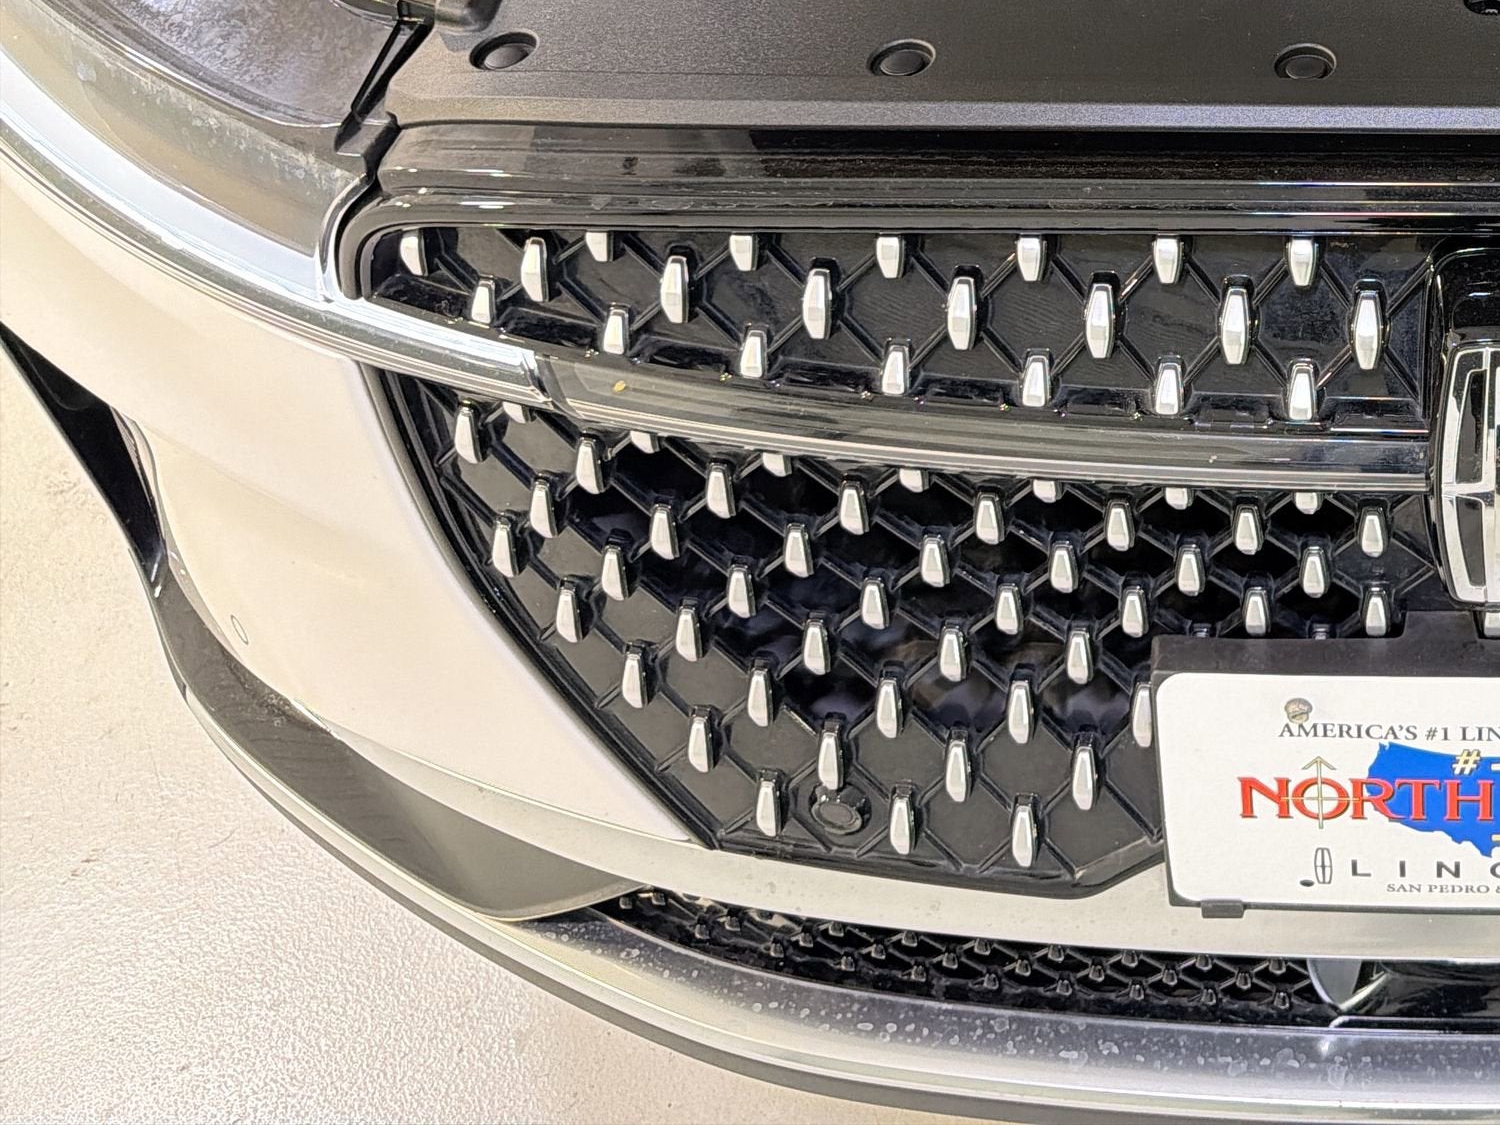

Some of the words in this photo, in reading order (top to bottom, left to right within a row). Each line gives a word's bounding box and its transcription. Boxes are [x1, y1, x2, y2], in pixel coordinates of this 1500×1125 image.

[1279, 723, 1418, 741] AMERICA'S
[1425, 725, 1450, 742] #1
[1237, 776, 1495, 822] NORTH
[1386, 883, 1422, 894] SAN
[1428, 884, 1491, 894] PEDRO
